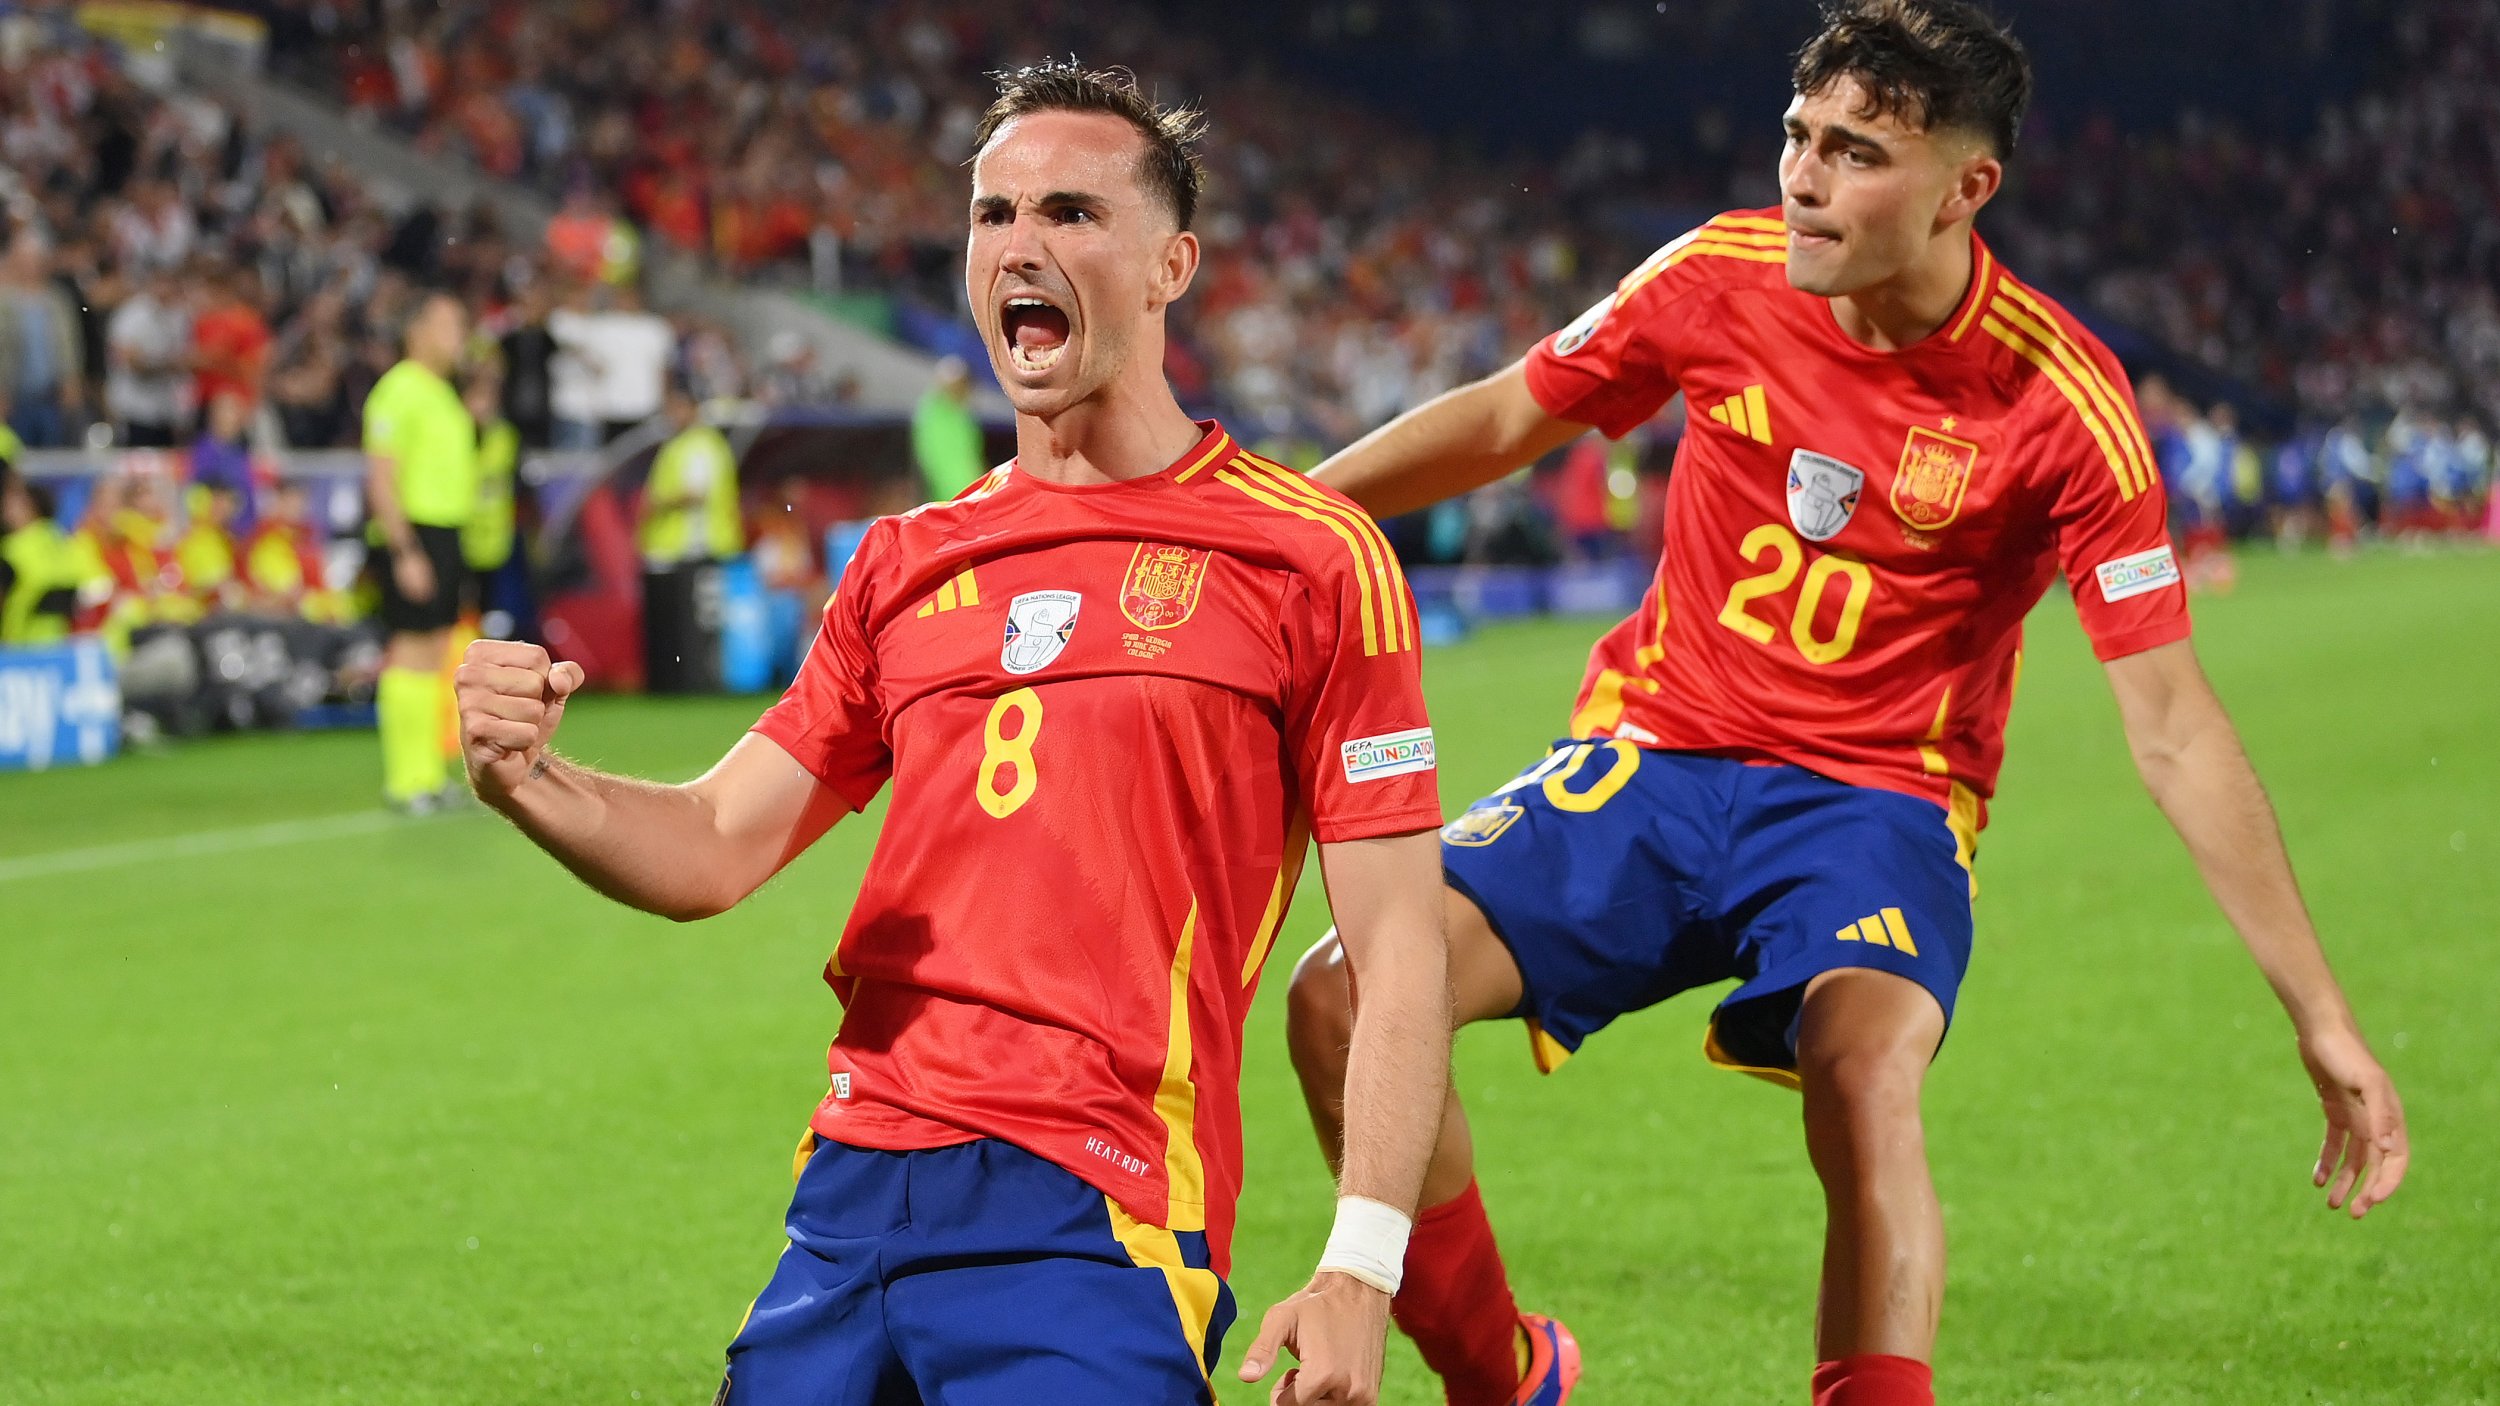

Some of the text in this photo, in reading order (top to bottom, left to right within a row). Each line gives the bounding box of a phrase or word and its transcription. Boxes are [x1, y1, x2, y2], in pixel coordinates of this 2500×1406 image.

[1030, 593, 1056, 601] NATIONS
[1056, 593, 1077, 601] LEAGUE
[1717, 523, 1873, 665] 20
[1145, 635, 1173, 649] GEORGIA
[1148, 644, 1166, 655] 2024
[975, 686, 1044, 819] 8
[1344, 741, 1372, 754] UEFA
[1085, 1136, 1150, 1177] HEAT.RDY
